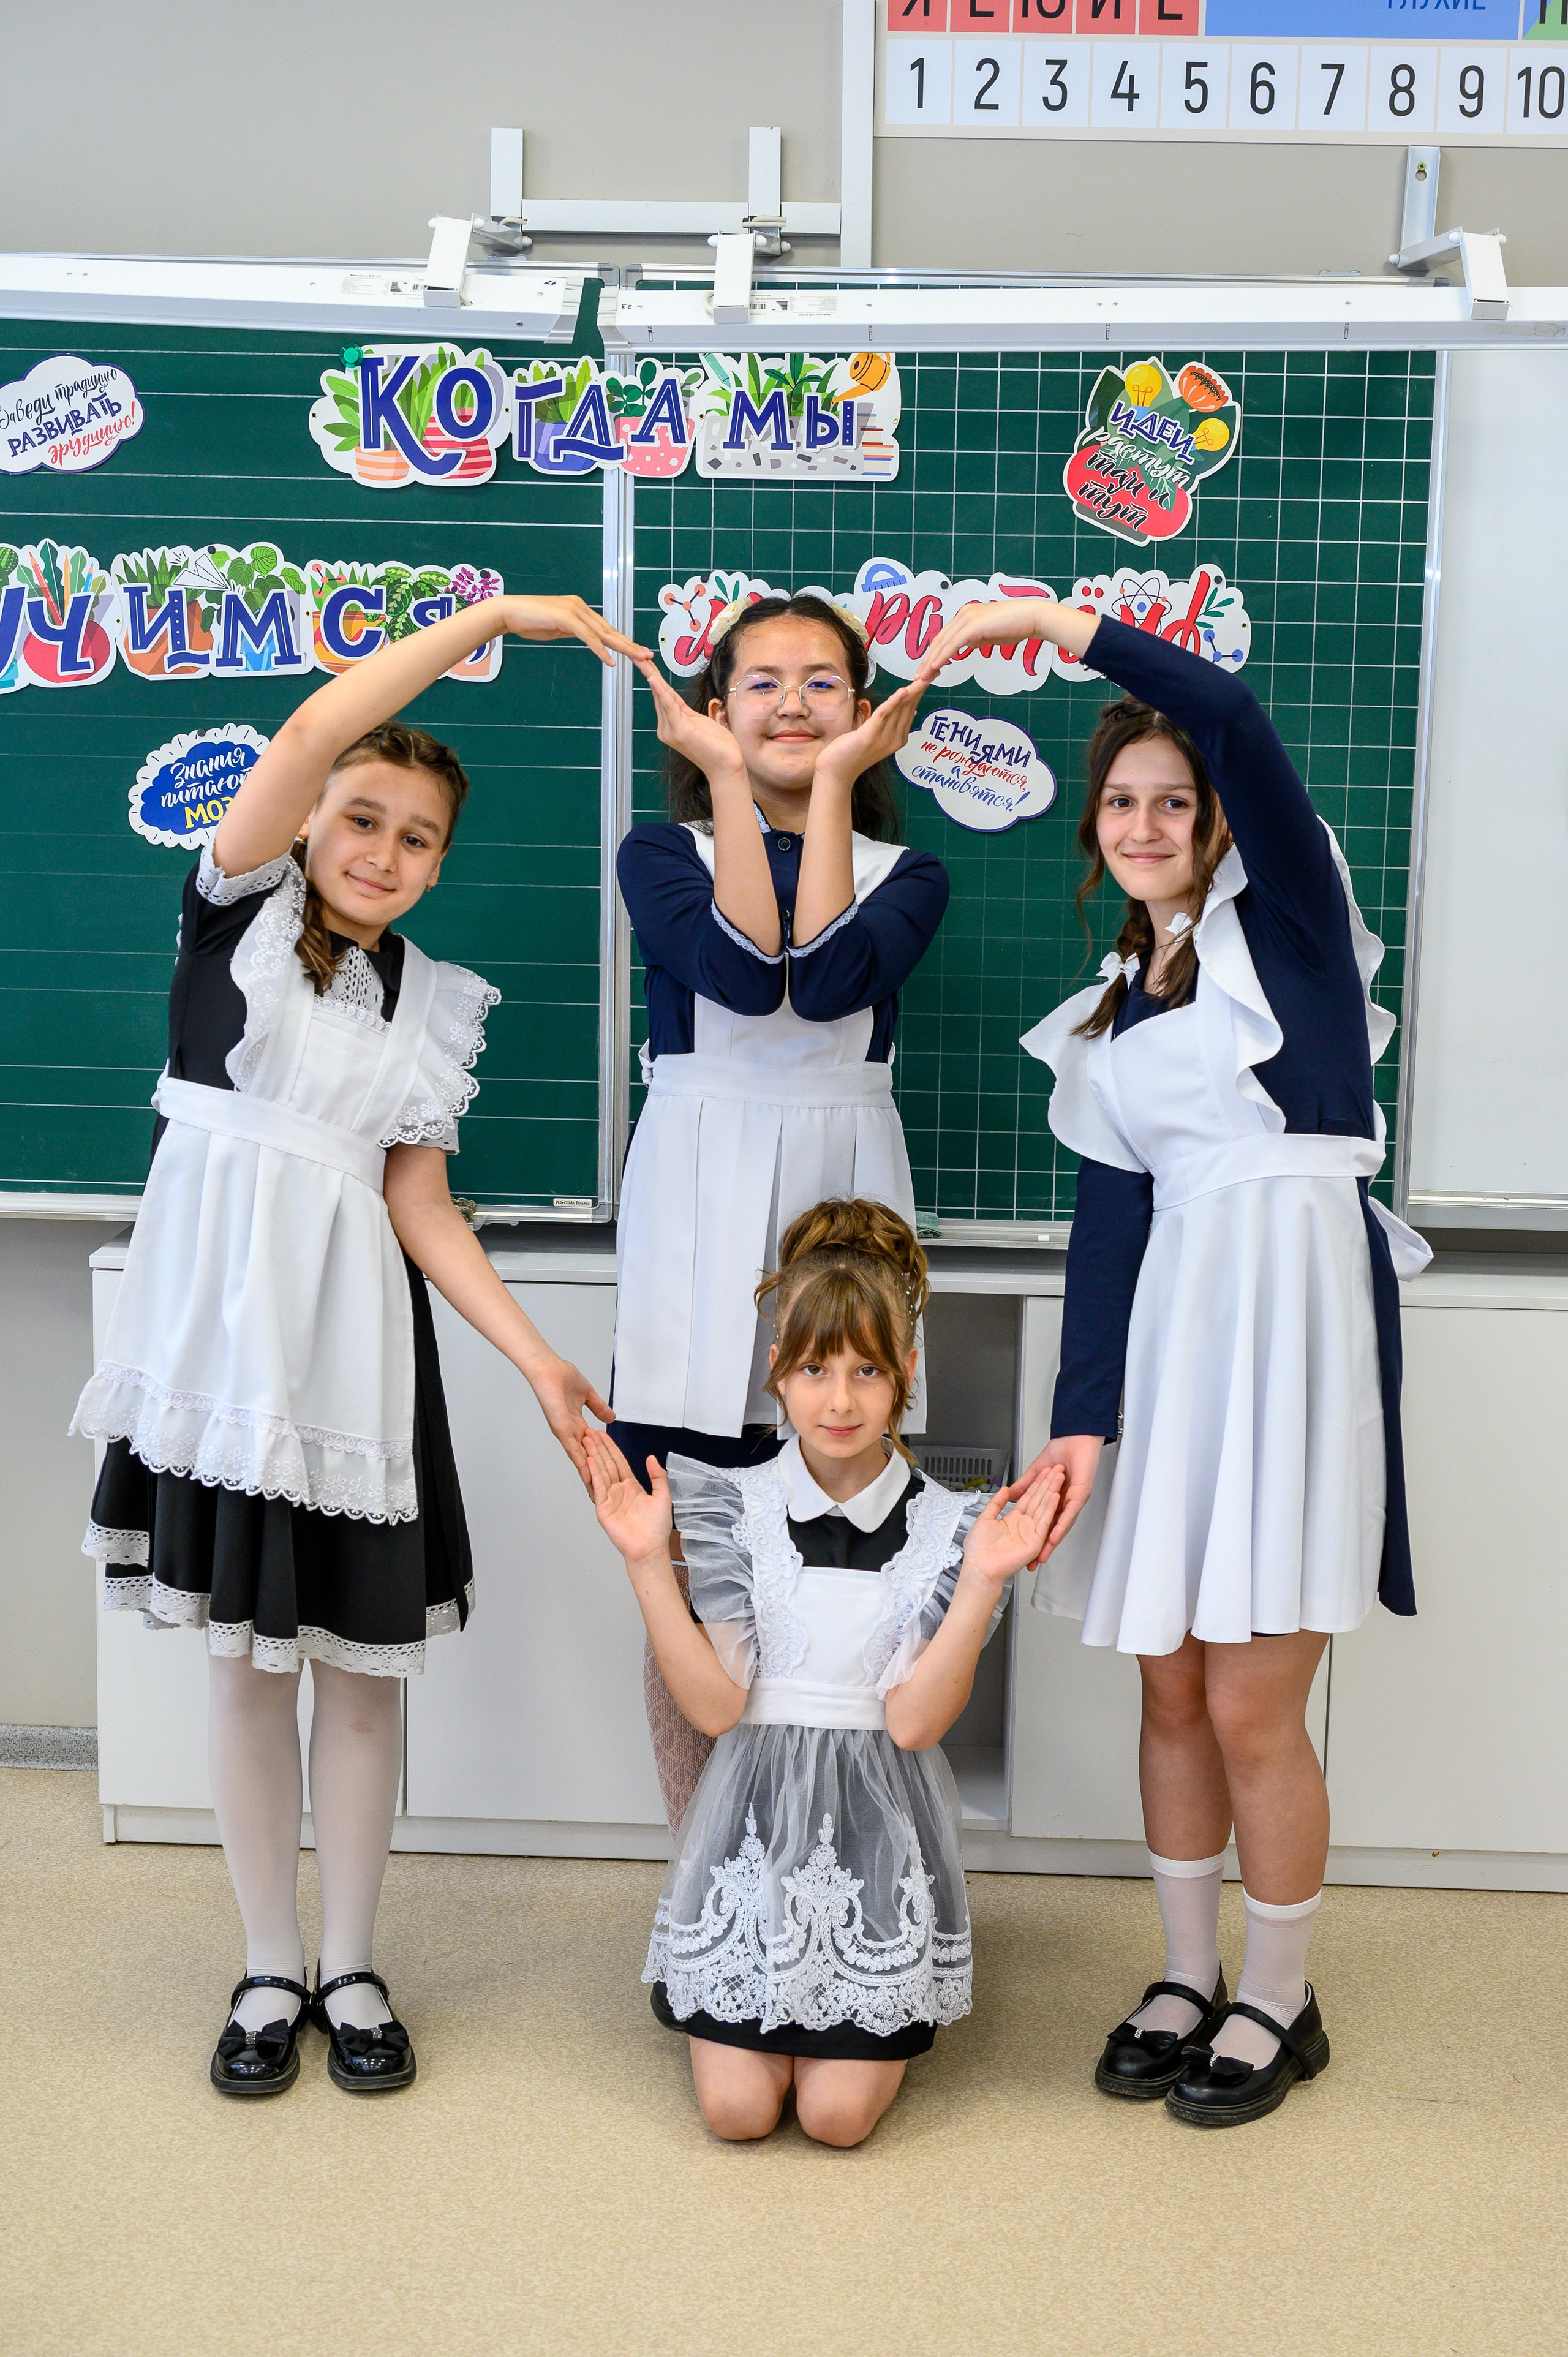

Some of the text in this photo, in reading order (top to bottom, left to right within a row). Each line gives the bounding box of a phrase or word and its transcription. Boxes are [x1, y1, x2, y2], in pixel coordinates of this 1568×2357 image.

[910, 58, 1566, 119] 1 2 3 4 5 6 7 8 9 10
[54, 369, 117, 407] традицию
[7, 392, 122, 458] РАЗВИВАТЬ
[48, 401, 136, 467] эрудицию!
[1110, 402, 1195, 464] ИДЕИ
[1082, 426, 1191, 490] растут
[1078, 479, 1148, 531] тут
[1148, 488, 1170, 510] и
[921, 741, 938, 753] не
[929, 715, 1031, 768] ГЕНИЯМИ
[911, 766, 1031, 812] становятся!
[951, 765, 960, 779] а
